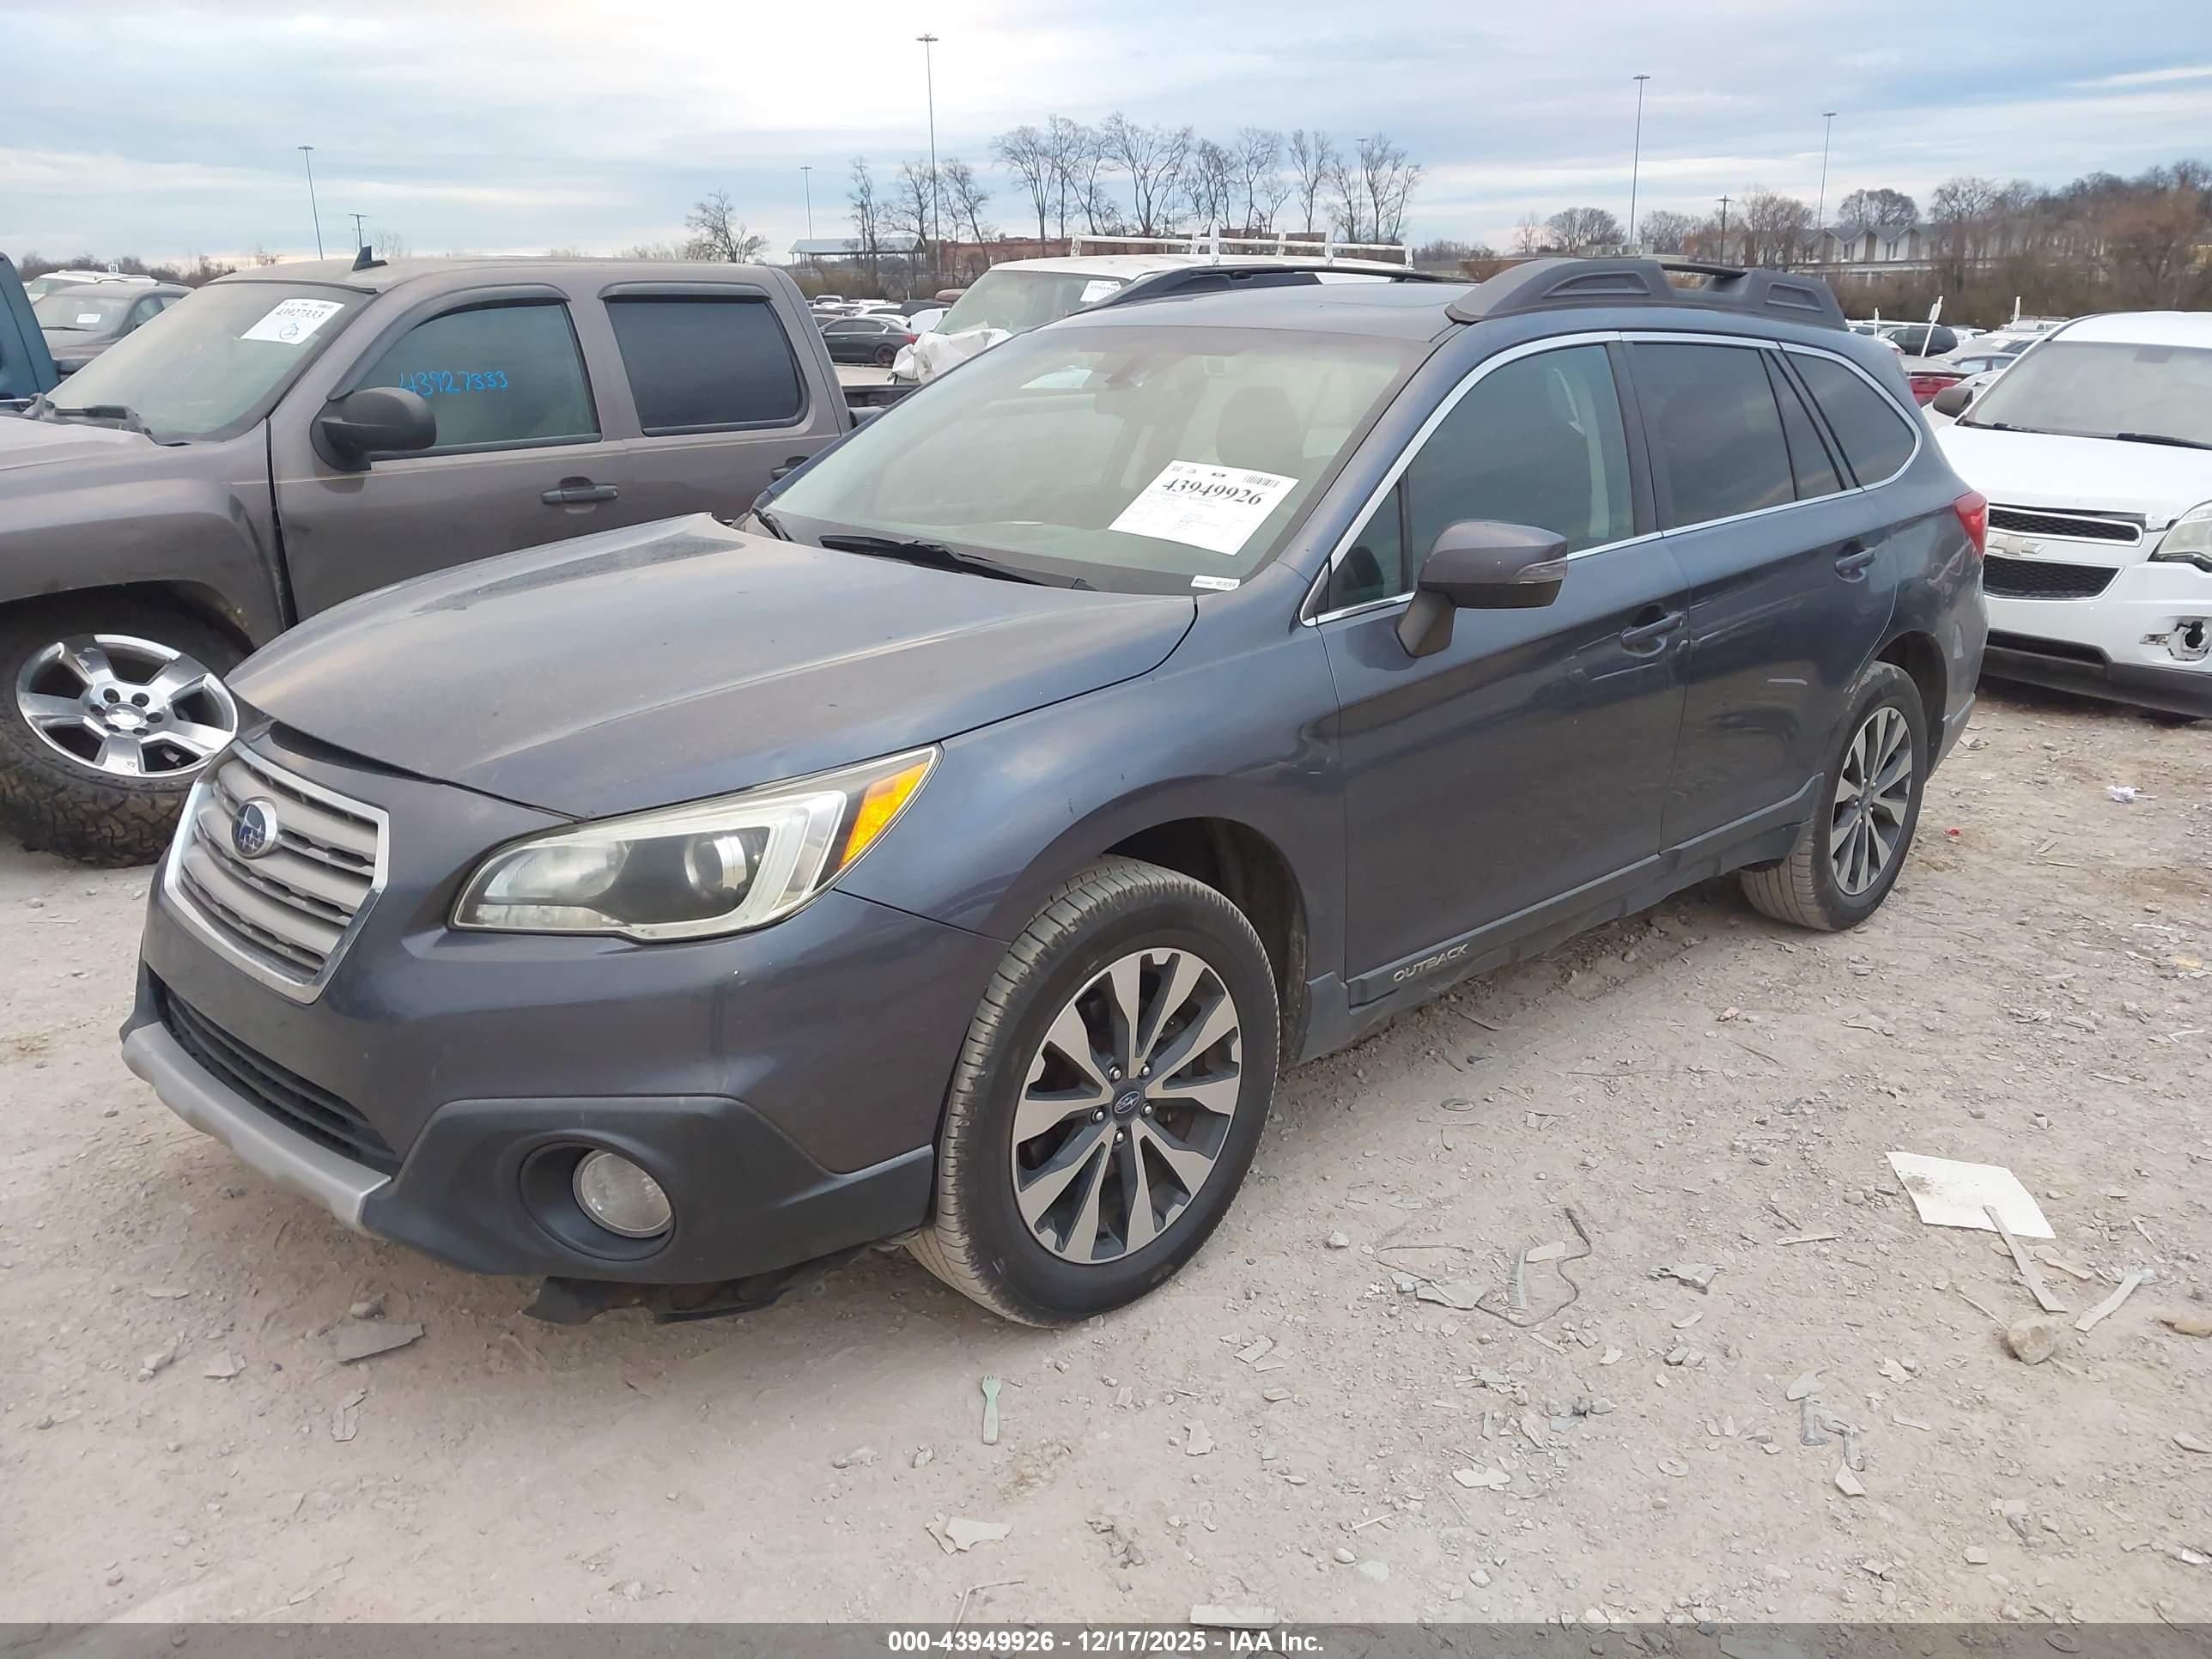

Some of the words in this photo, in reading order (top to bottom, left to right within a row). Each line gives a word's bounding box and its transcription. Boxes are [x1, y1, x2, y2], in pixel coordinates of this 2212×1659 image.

[398, 370, 508, 396] 43927333
[1163, 477, 1267, 506] 43949926
[1393, 943, 1469, 982] OUTBACK
